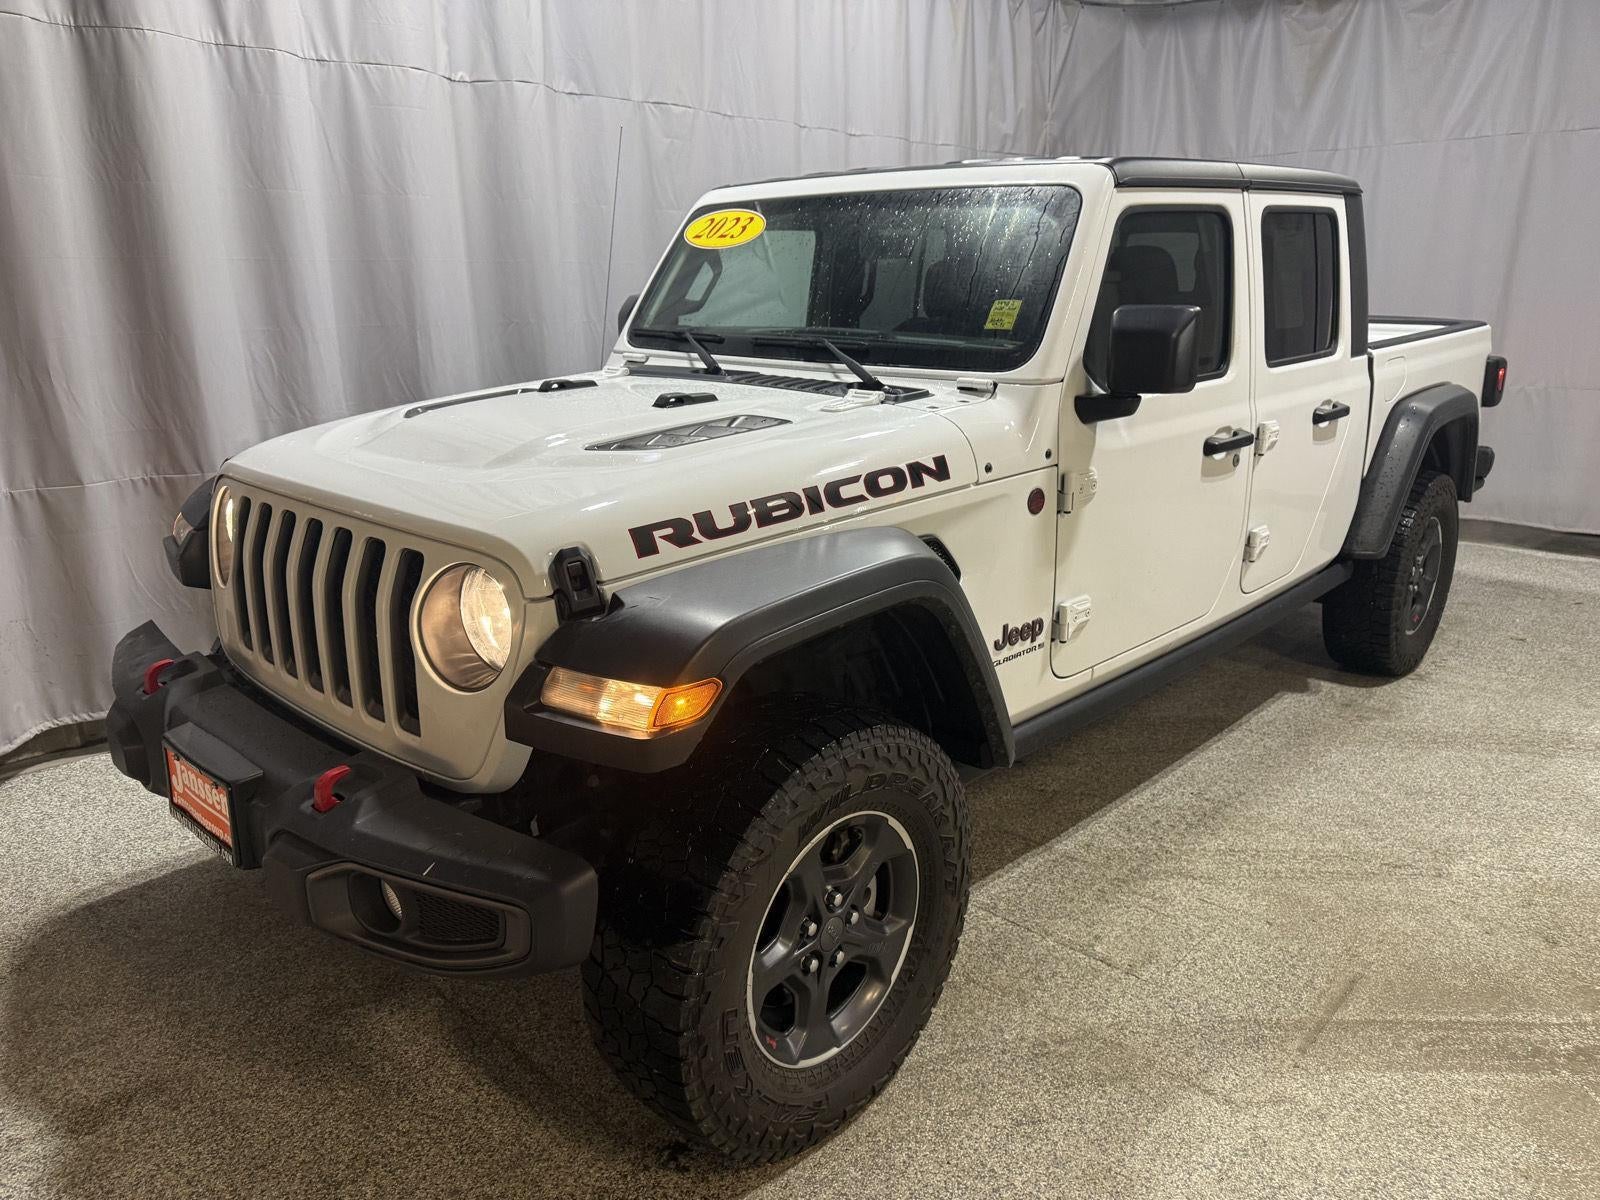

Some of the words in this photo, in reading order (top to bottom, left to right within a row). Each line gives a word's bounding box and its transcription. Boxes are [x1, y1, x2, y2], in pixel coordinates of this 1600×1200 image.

[692, 216, 755, 239] 2023
[628, 454, 951, 559] RUBICON
[994, 616, 1044, 651] Jeep
[992, 645, 1037, 668] GLADIATOR
[172, 759, 229, 817] Janssen
